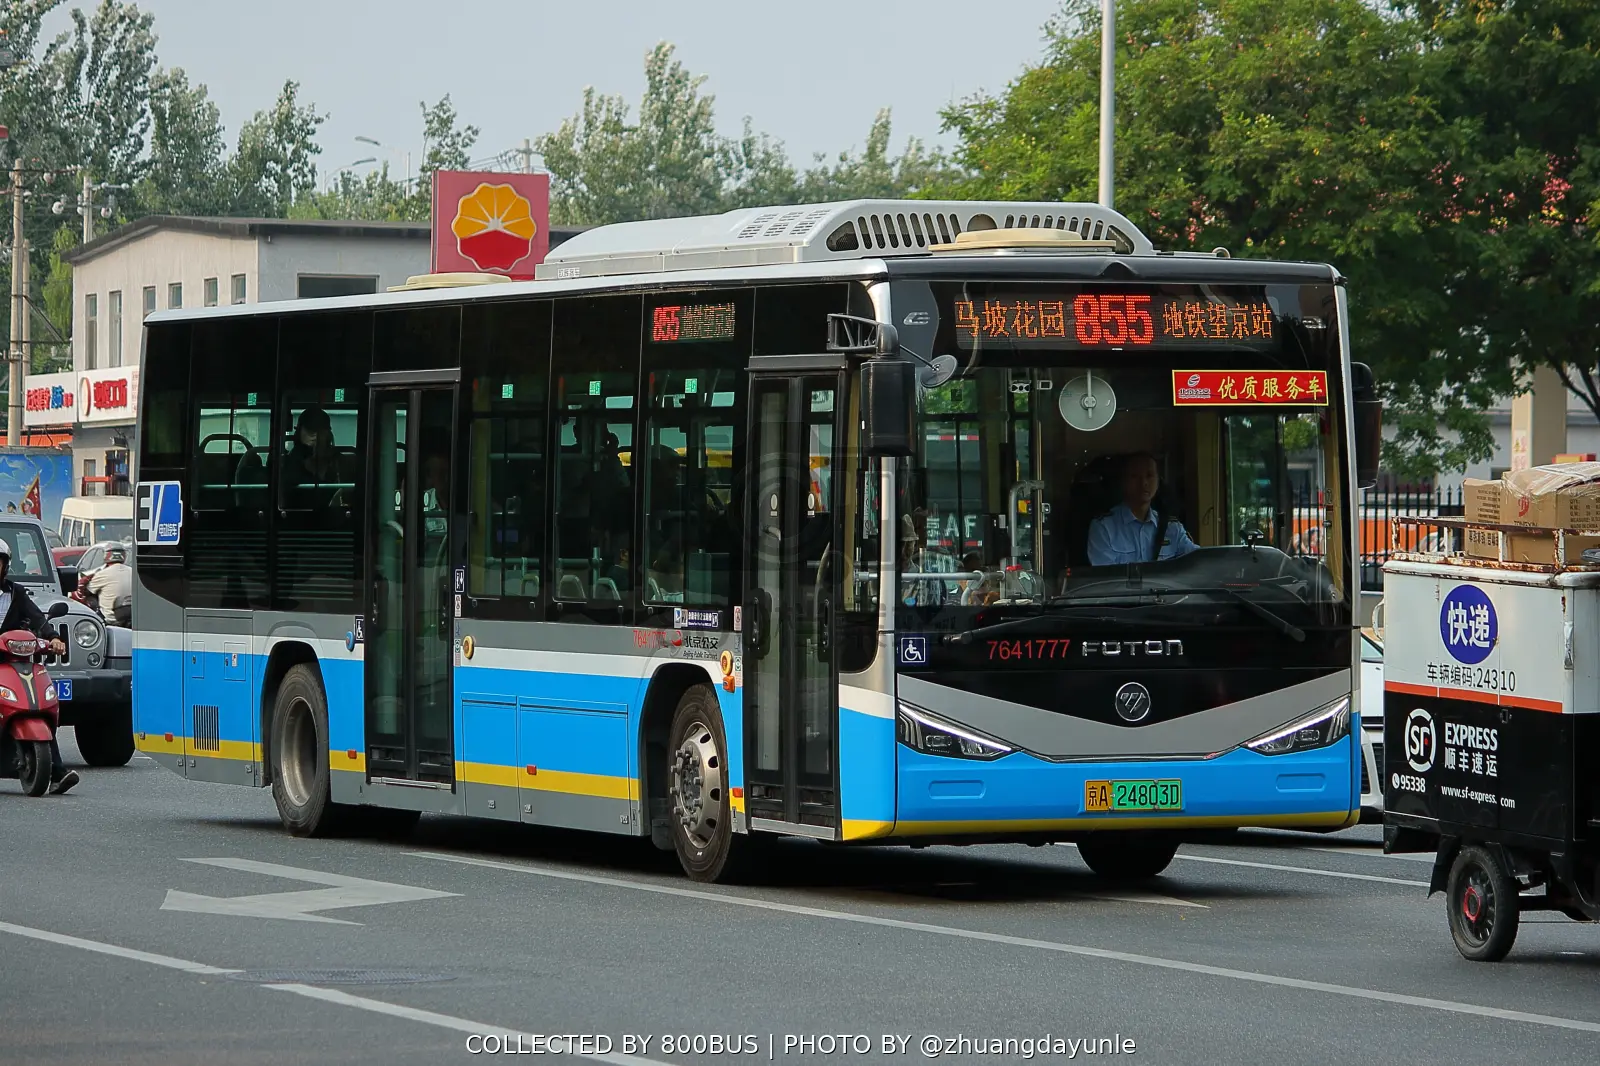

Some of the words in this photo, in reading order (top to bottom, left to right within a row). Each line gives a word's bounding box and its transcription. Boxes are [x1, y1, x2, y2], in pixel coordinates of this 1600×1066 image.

[954, 301, 1066, 338] 马坡花园
[1073, 294, 1154, 345] 855
[1162, 302, 1273, 339] 地铁望京站
[1217, 375, 1323, 400] 优质服务车
[1447, 601, 1490, 648] 快递
[684, 636, 719, 649] 北京公交
[987, 640, 1070, 659] 7641777
[1082, 639, 1184, 657] FOTON
[1410, 725, 1430, 756] SF
[1444, 722, 1498, 751] EXPRESS
[1444, 747, 1498, 777] 顺丰速运
[1400, 775, 1426, 793] 95338
